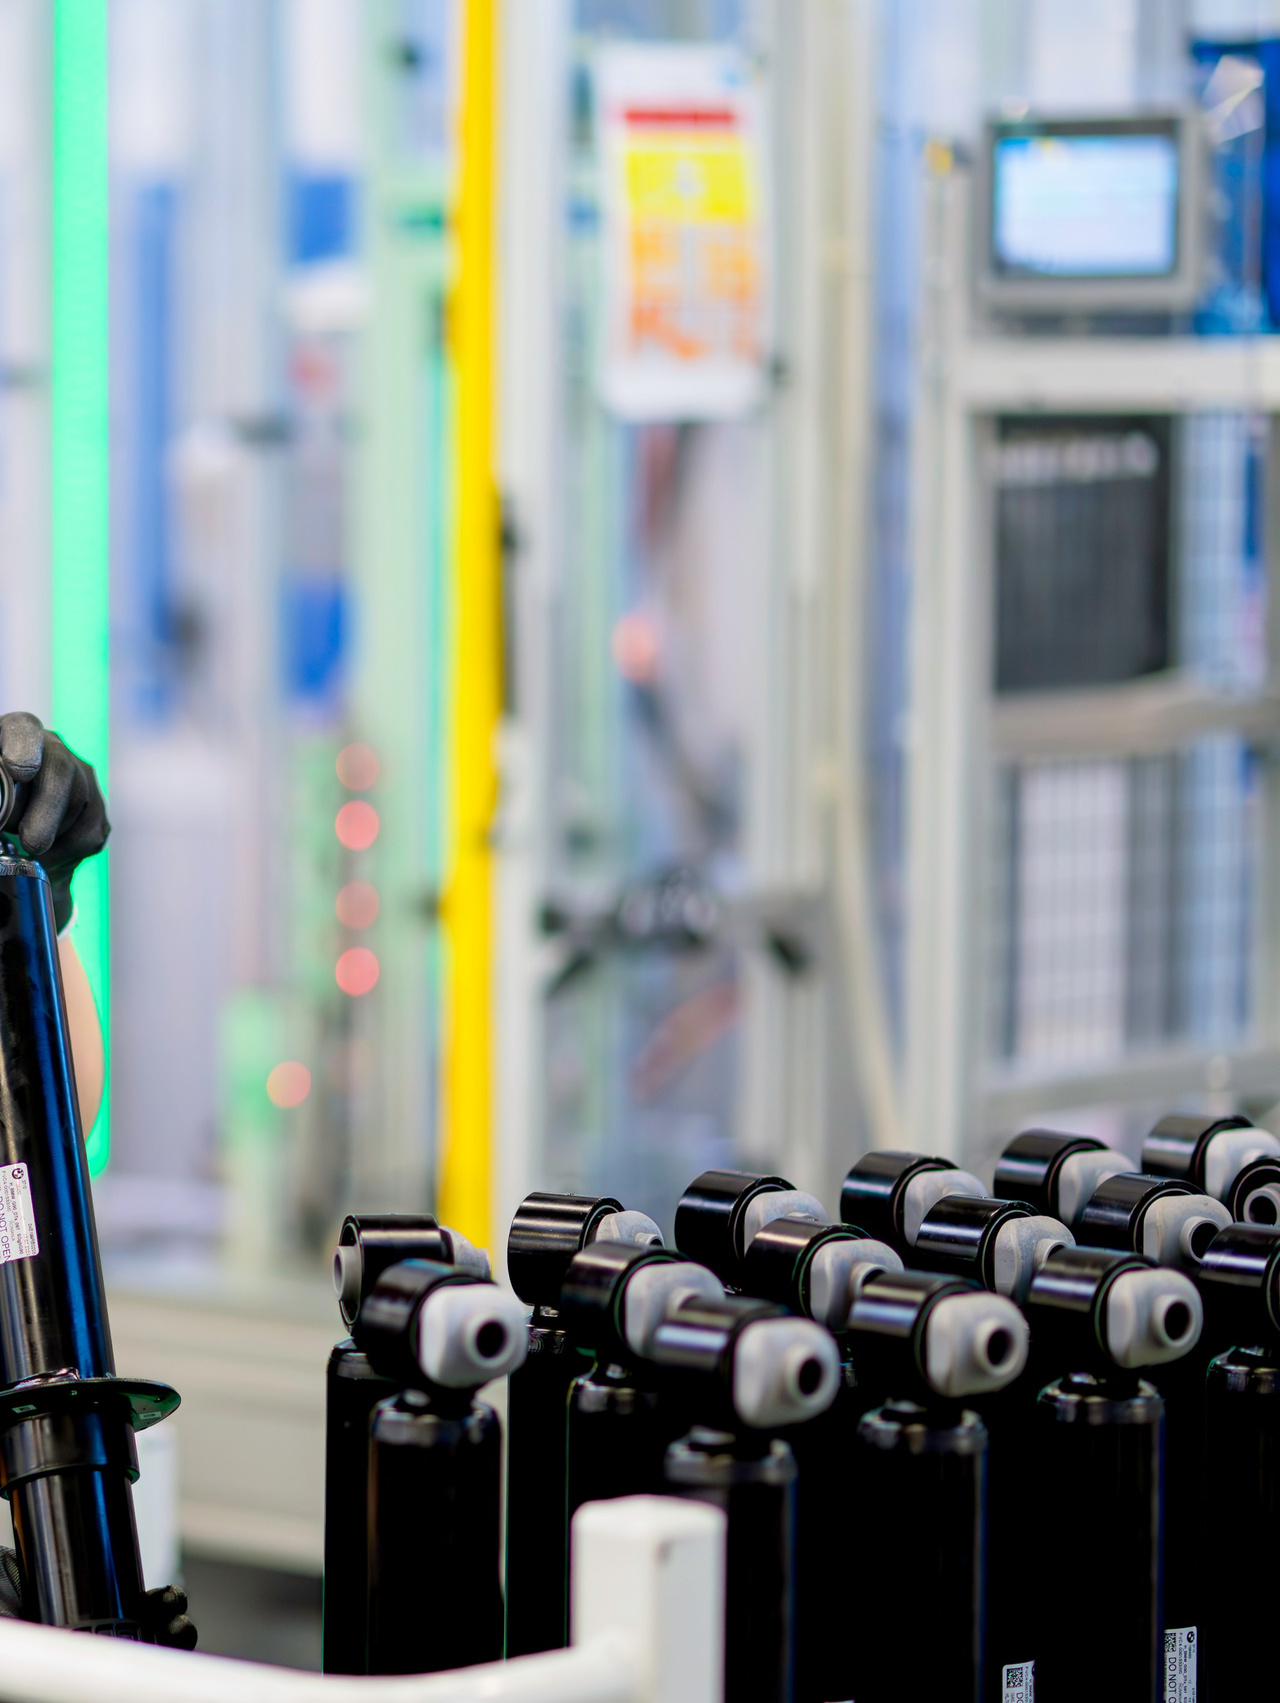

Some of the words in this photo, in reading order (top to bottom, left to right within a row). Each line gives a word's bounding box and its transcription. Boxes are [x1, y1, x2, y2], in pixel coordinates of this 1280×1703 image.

[0, 1236, 12, 1262] OPEN
[1169, 1657, 1177, 1672] DO
[1169, 1674, 1177, 1694] NOT
